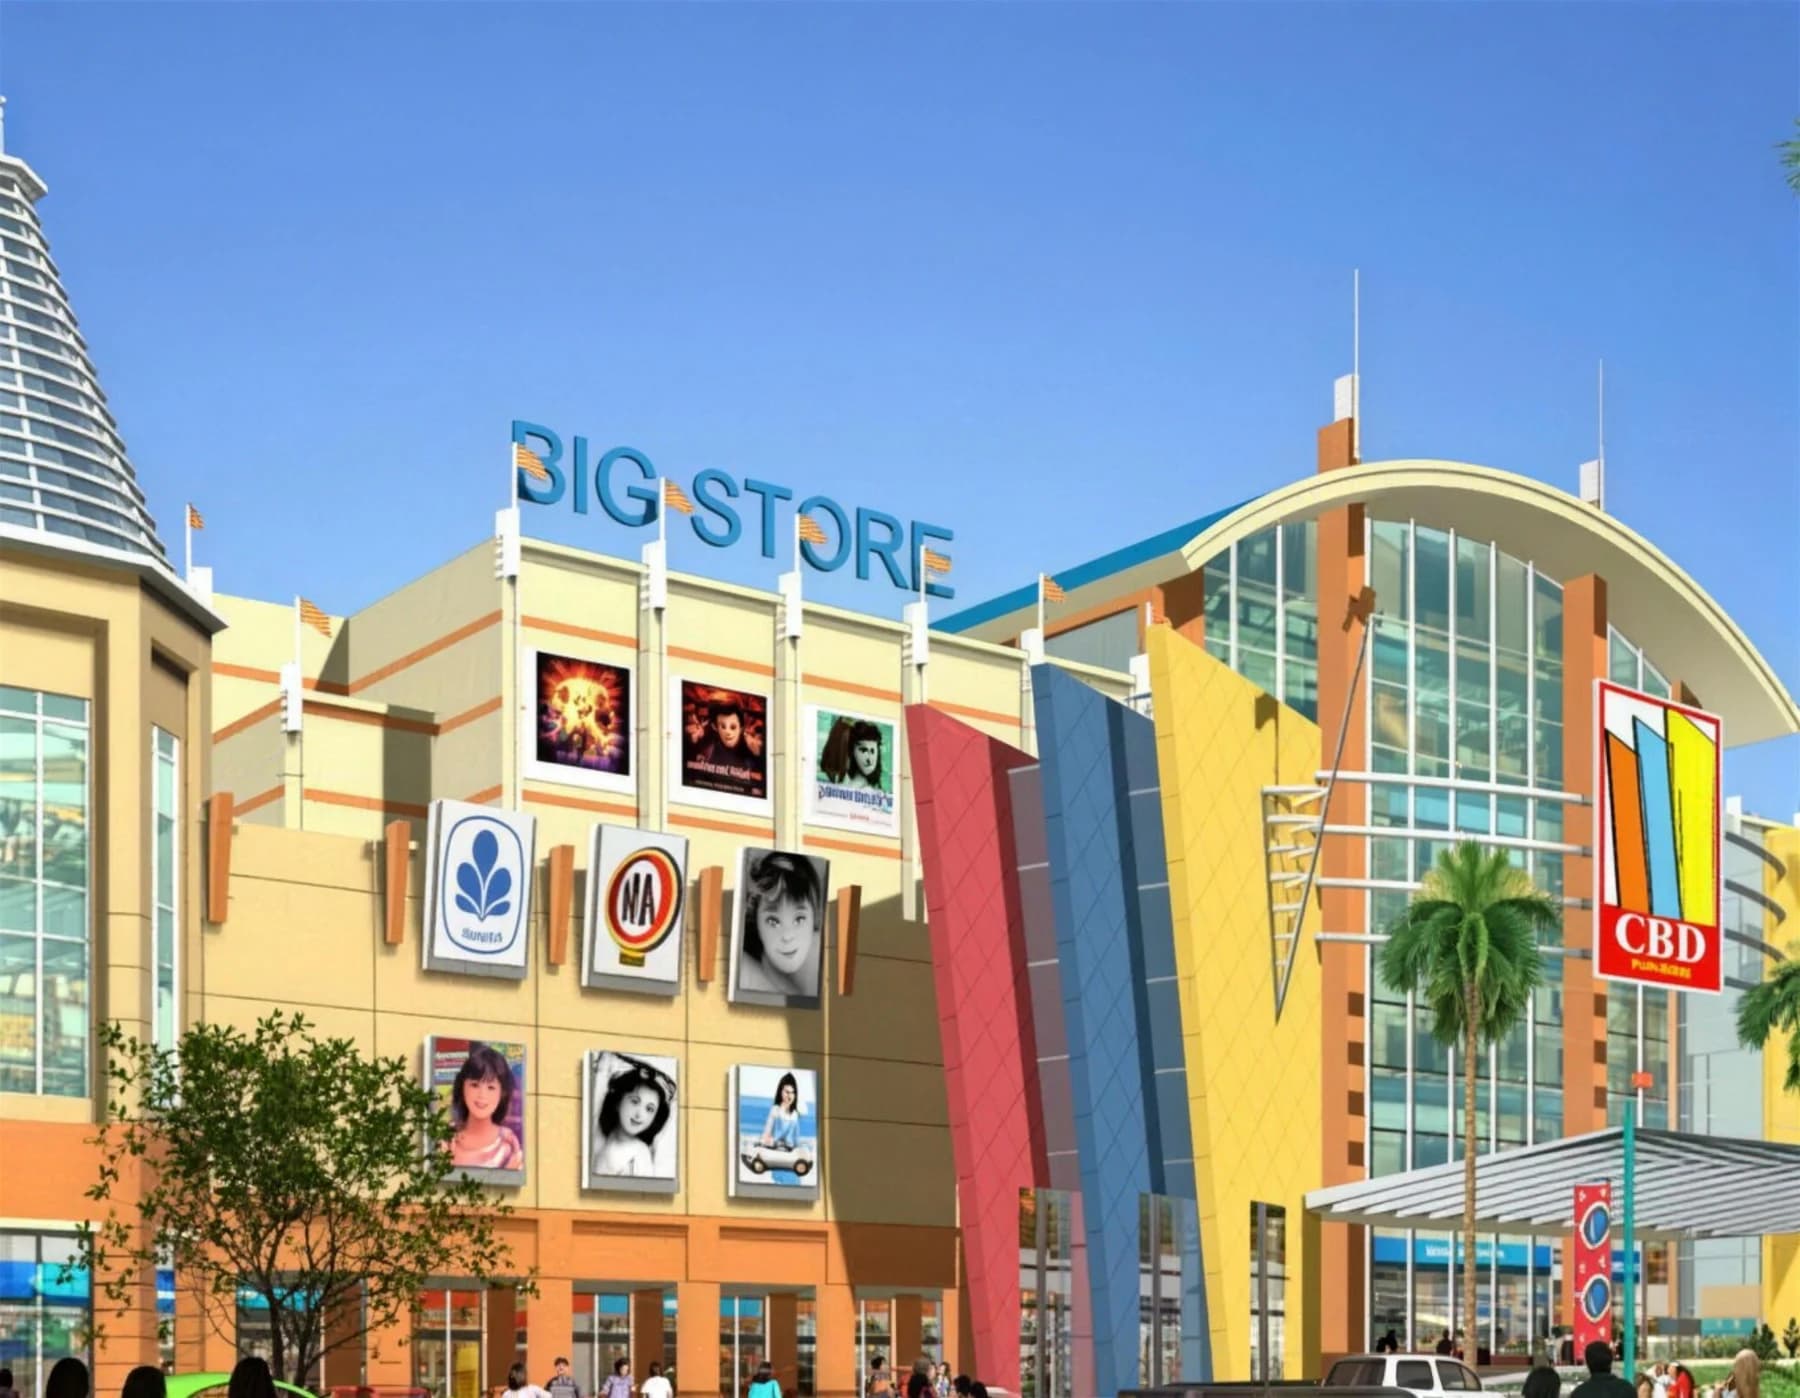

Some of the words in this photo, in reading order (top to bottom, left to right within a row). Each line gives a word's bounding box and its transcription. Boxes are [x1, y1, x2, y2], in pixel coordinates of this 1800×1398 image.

[511, 419, 659, 527] BIG
[690, 468, 955, 599] STORE
[621, 872, 656, 926] NA
[1615, 912, 1706, 964] CBD
